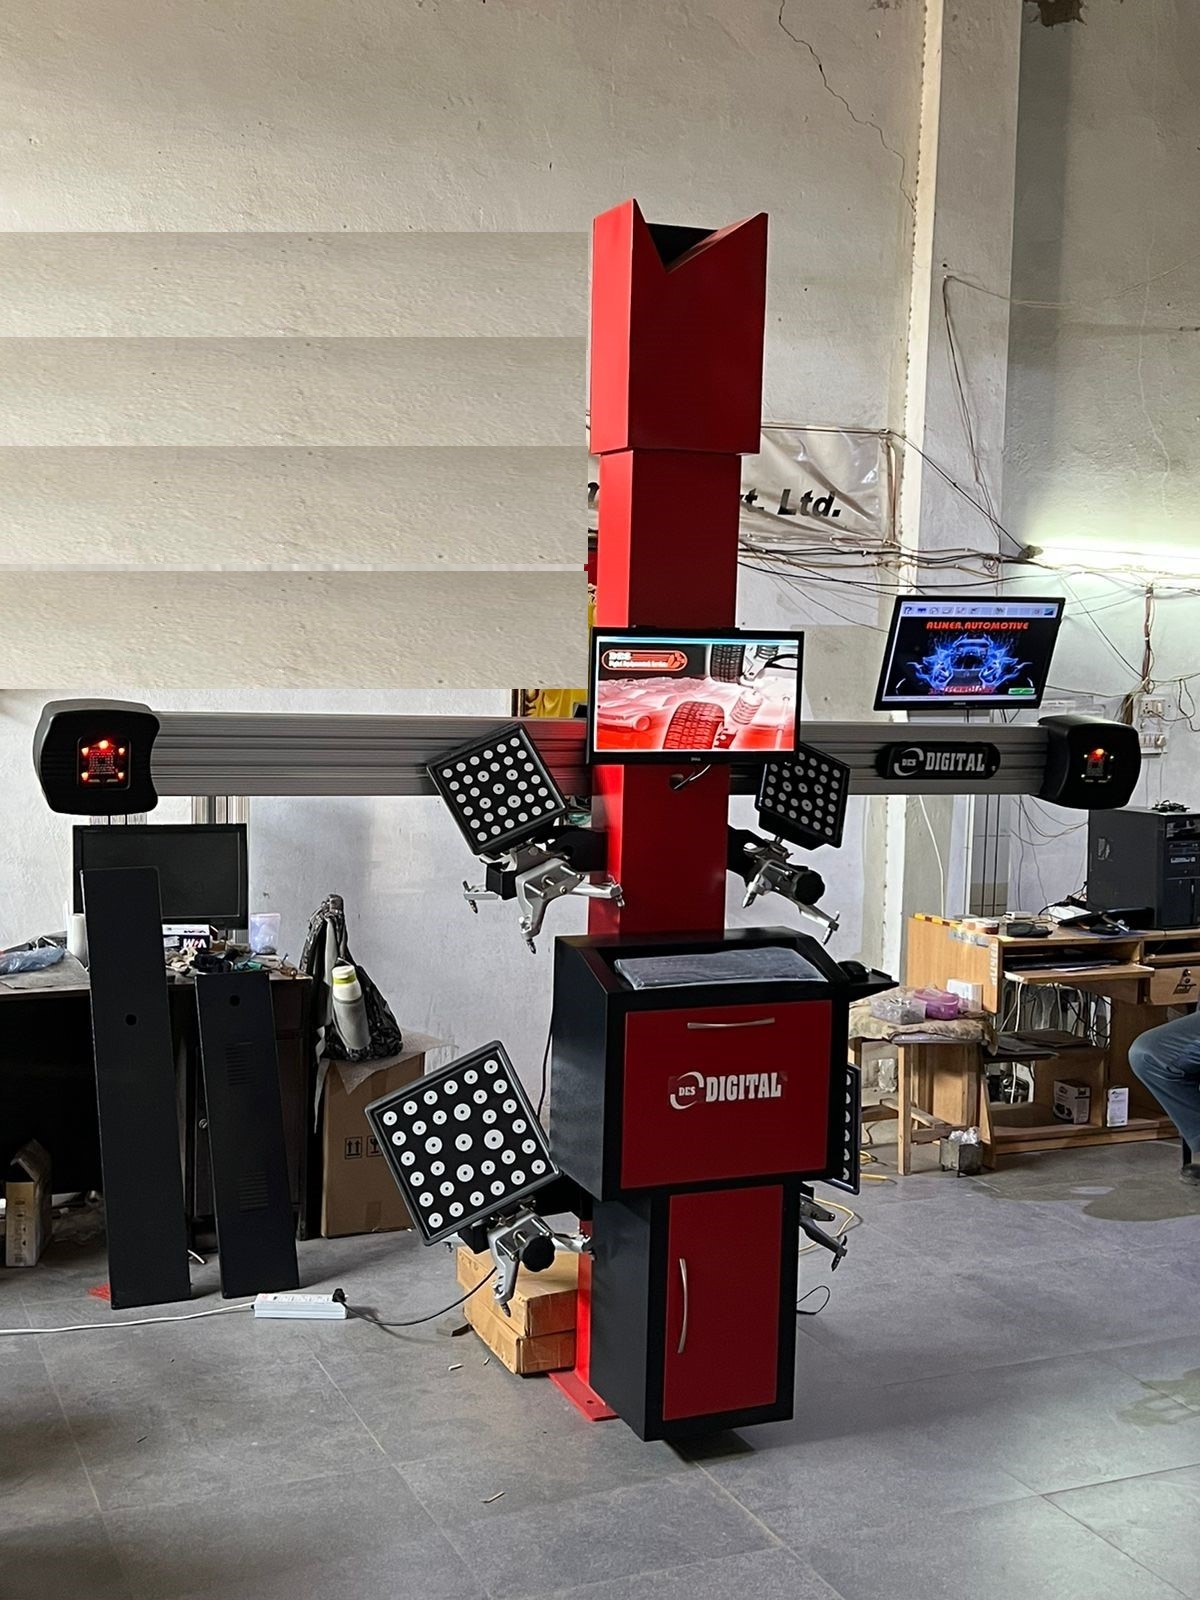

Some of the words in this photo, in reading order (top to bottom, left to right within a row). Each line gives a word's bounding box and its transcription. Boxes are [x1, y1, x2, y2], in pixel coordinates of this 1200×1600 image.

[777, 488, 842, 517] Ltd.
[964, 621, 1030, 631] AUTOMOTIVE
[925, 752, 985, 771] DIGITAL
[678, 1086, 696, 1097] DES
[705, 1072, 782, 1103] DIGITAL
